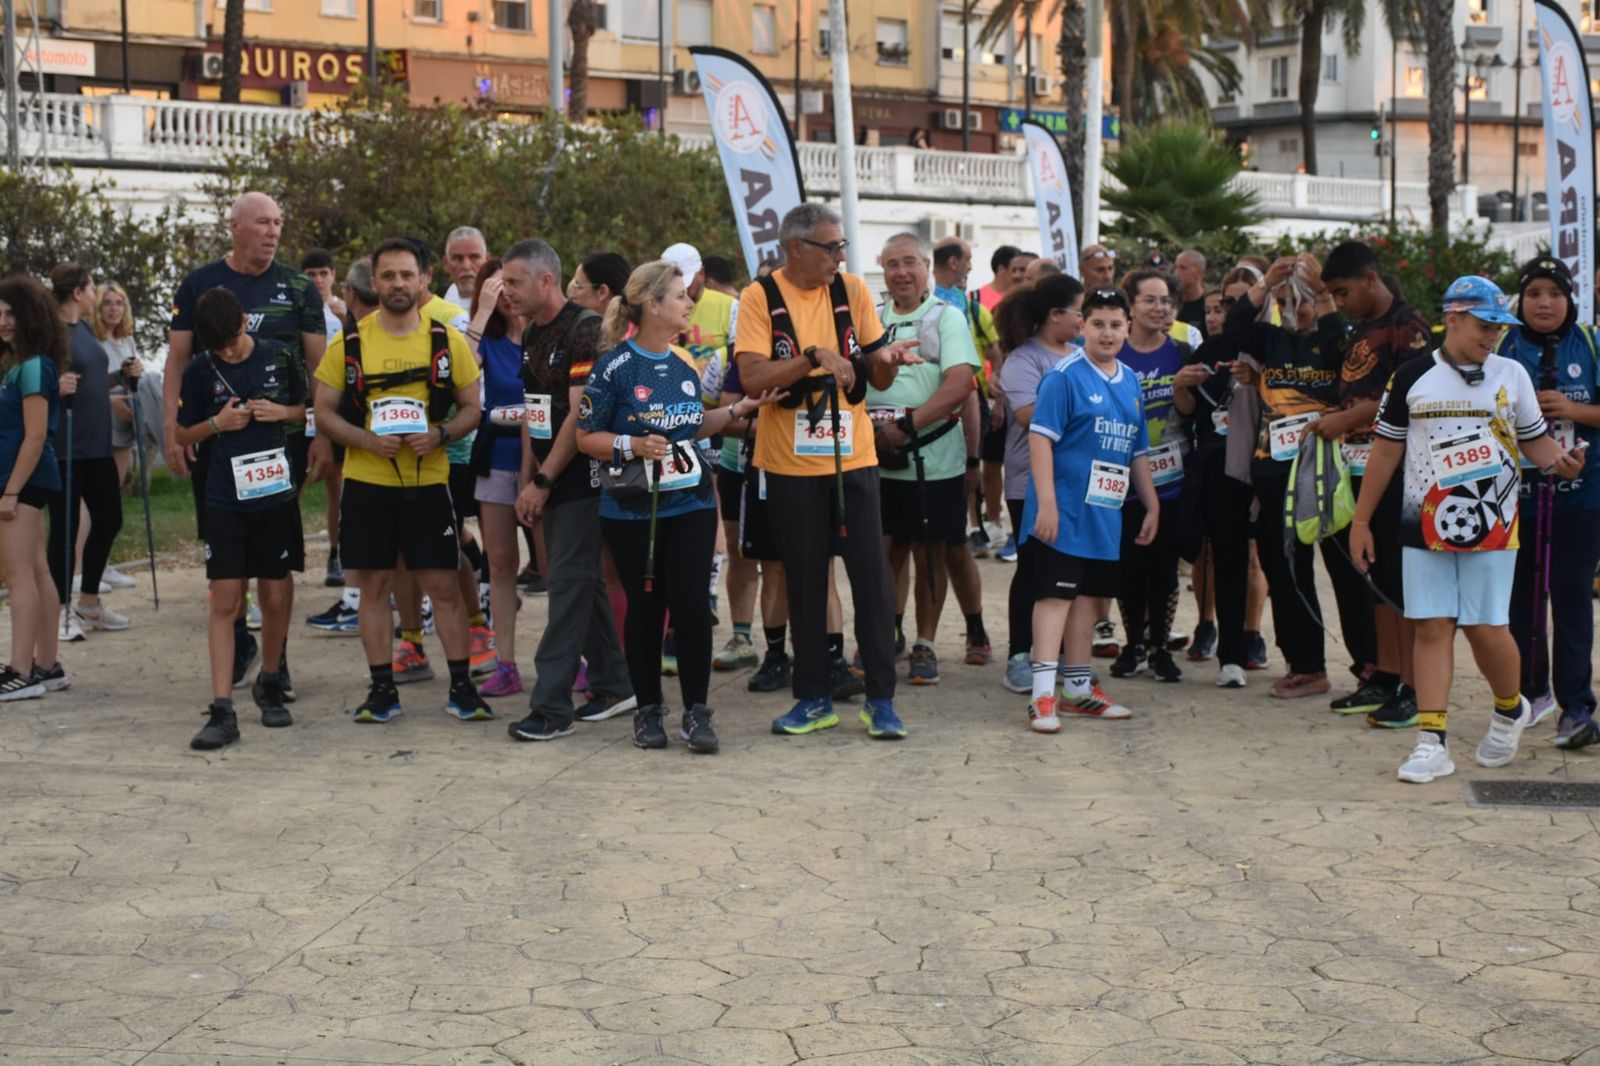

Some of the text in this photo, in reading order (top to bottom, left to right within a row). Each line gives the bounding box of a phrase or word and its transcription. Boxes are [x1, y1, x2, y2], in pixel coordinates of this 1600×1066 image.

[27, 49, 88, 66] Atomoto
[1445, 400, 1472, 409] CEUTA
[379, 408, 420, 422] 1360
[1443, 445, 1491, 469] 1389
[245, 464, 285, 483] 1354
[1097, 477, 1126, 493] 1382
